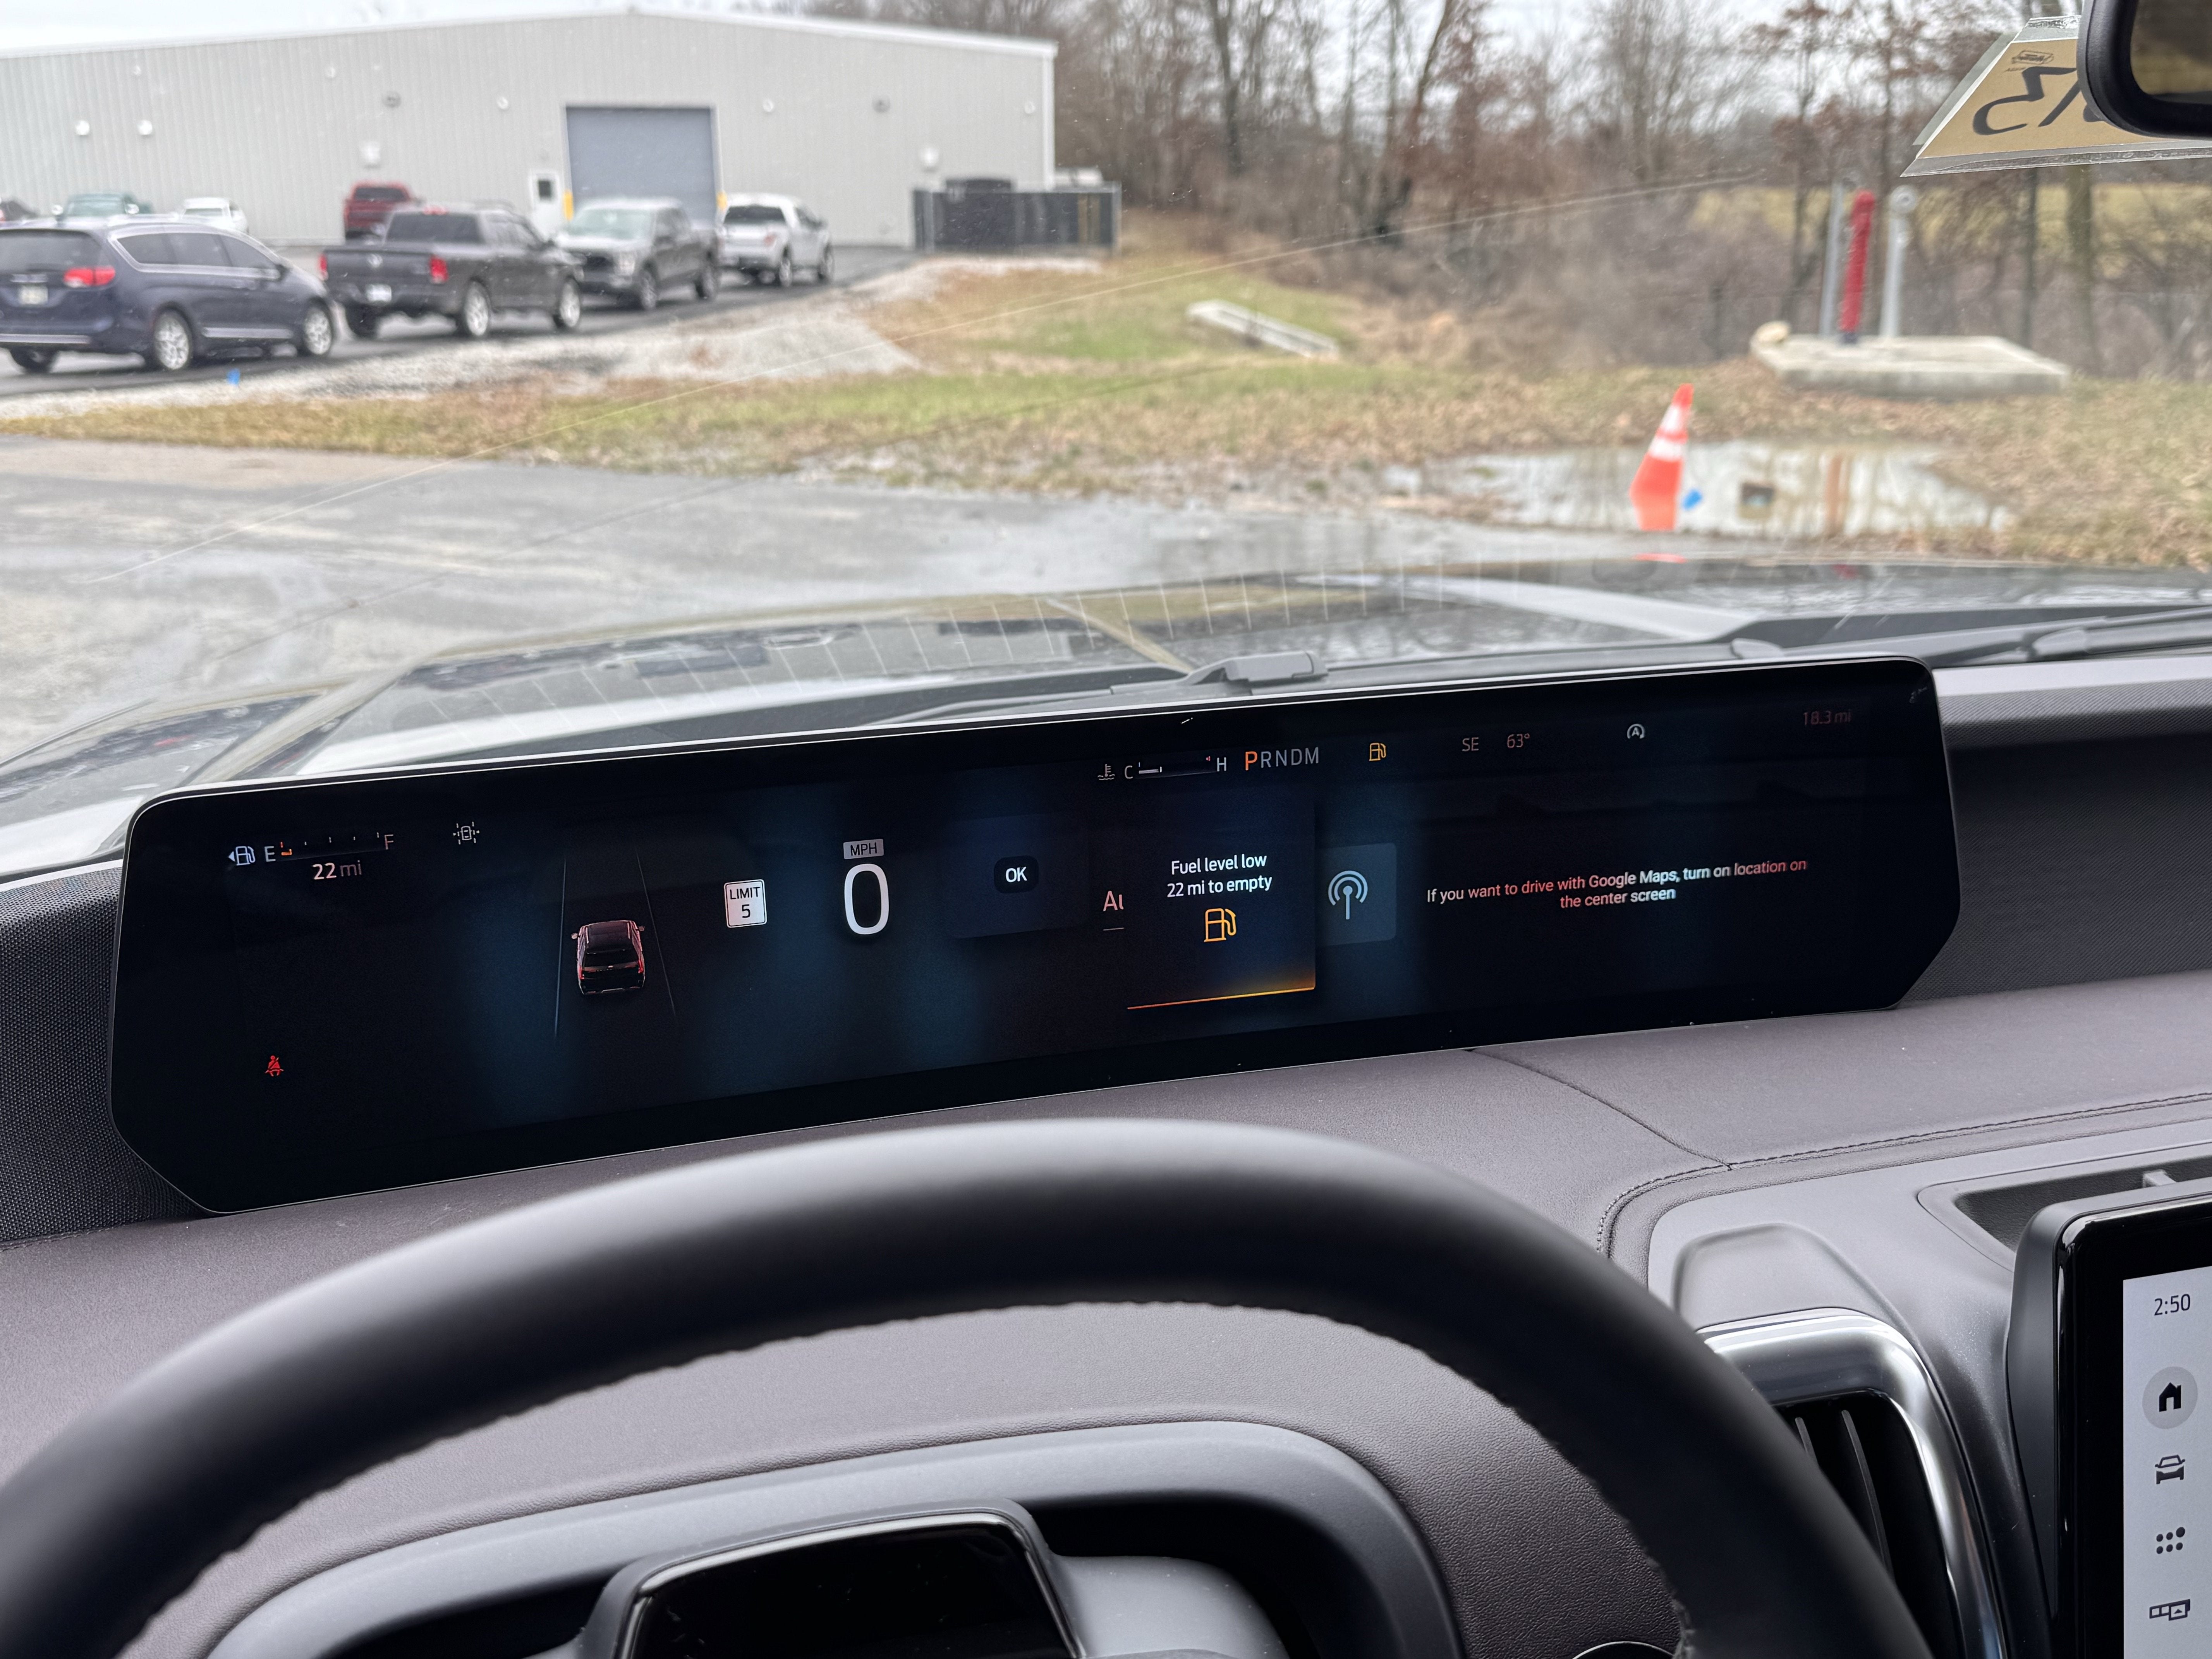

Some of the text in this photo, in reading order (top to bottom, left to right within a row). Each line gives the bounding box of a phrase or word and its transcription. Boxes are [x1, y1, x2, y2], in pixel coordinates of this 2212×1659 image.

[1803, 708, 1851, 725] 18.3 mi
[1462, 737, 1479, 752] SE
[1124, 765, 1133, 780] C
[1216, 757, 1227, 772] H
[384, 834, 394, 850] F
[850, 842, 878, 856] MPH
[264, 845, 276, 862] E
[313, 860, 362, 880] 22 mi
[1171, 854, 1267, 875] Fuel level low
[1005, 866, 1028, 883] OK
[1427, 860, 1808, 905] If you want to drive with Google Maps, turn on location on
[729, 886, 761, 900] LIMIT
[1167, 875, 1273, 898] 22 mi to empty
[843, 863, 890, 935] 0
[1560, 888, 1677, 909] the center screen
[741, 904, 751, 919] 5
[2154, 1293, 2191, 1316] 2:50
